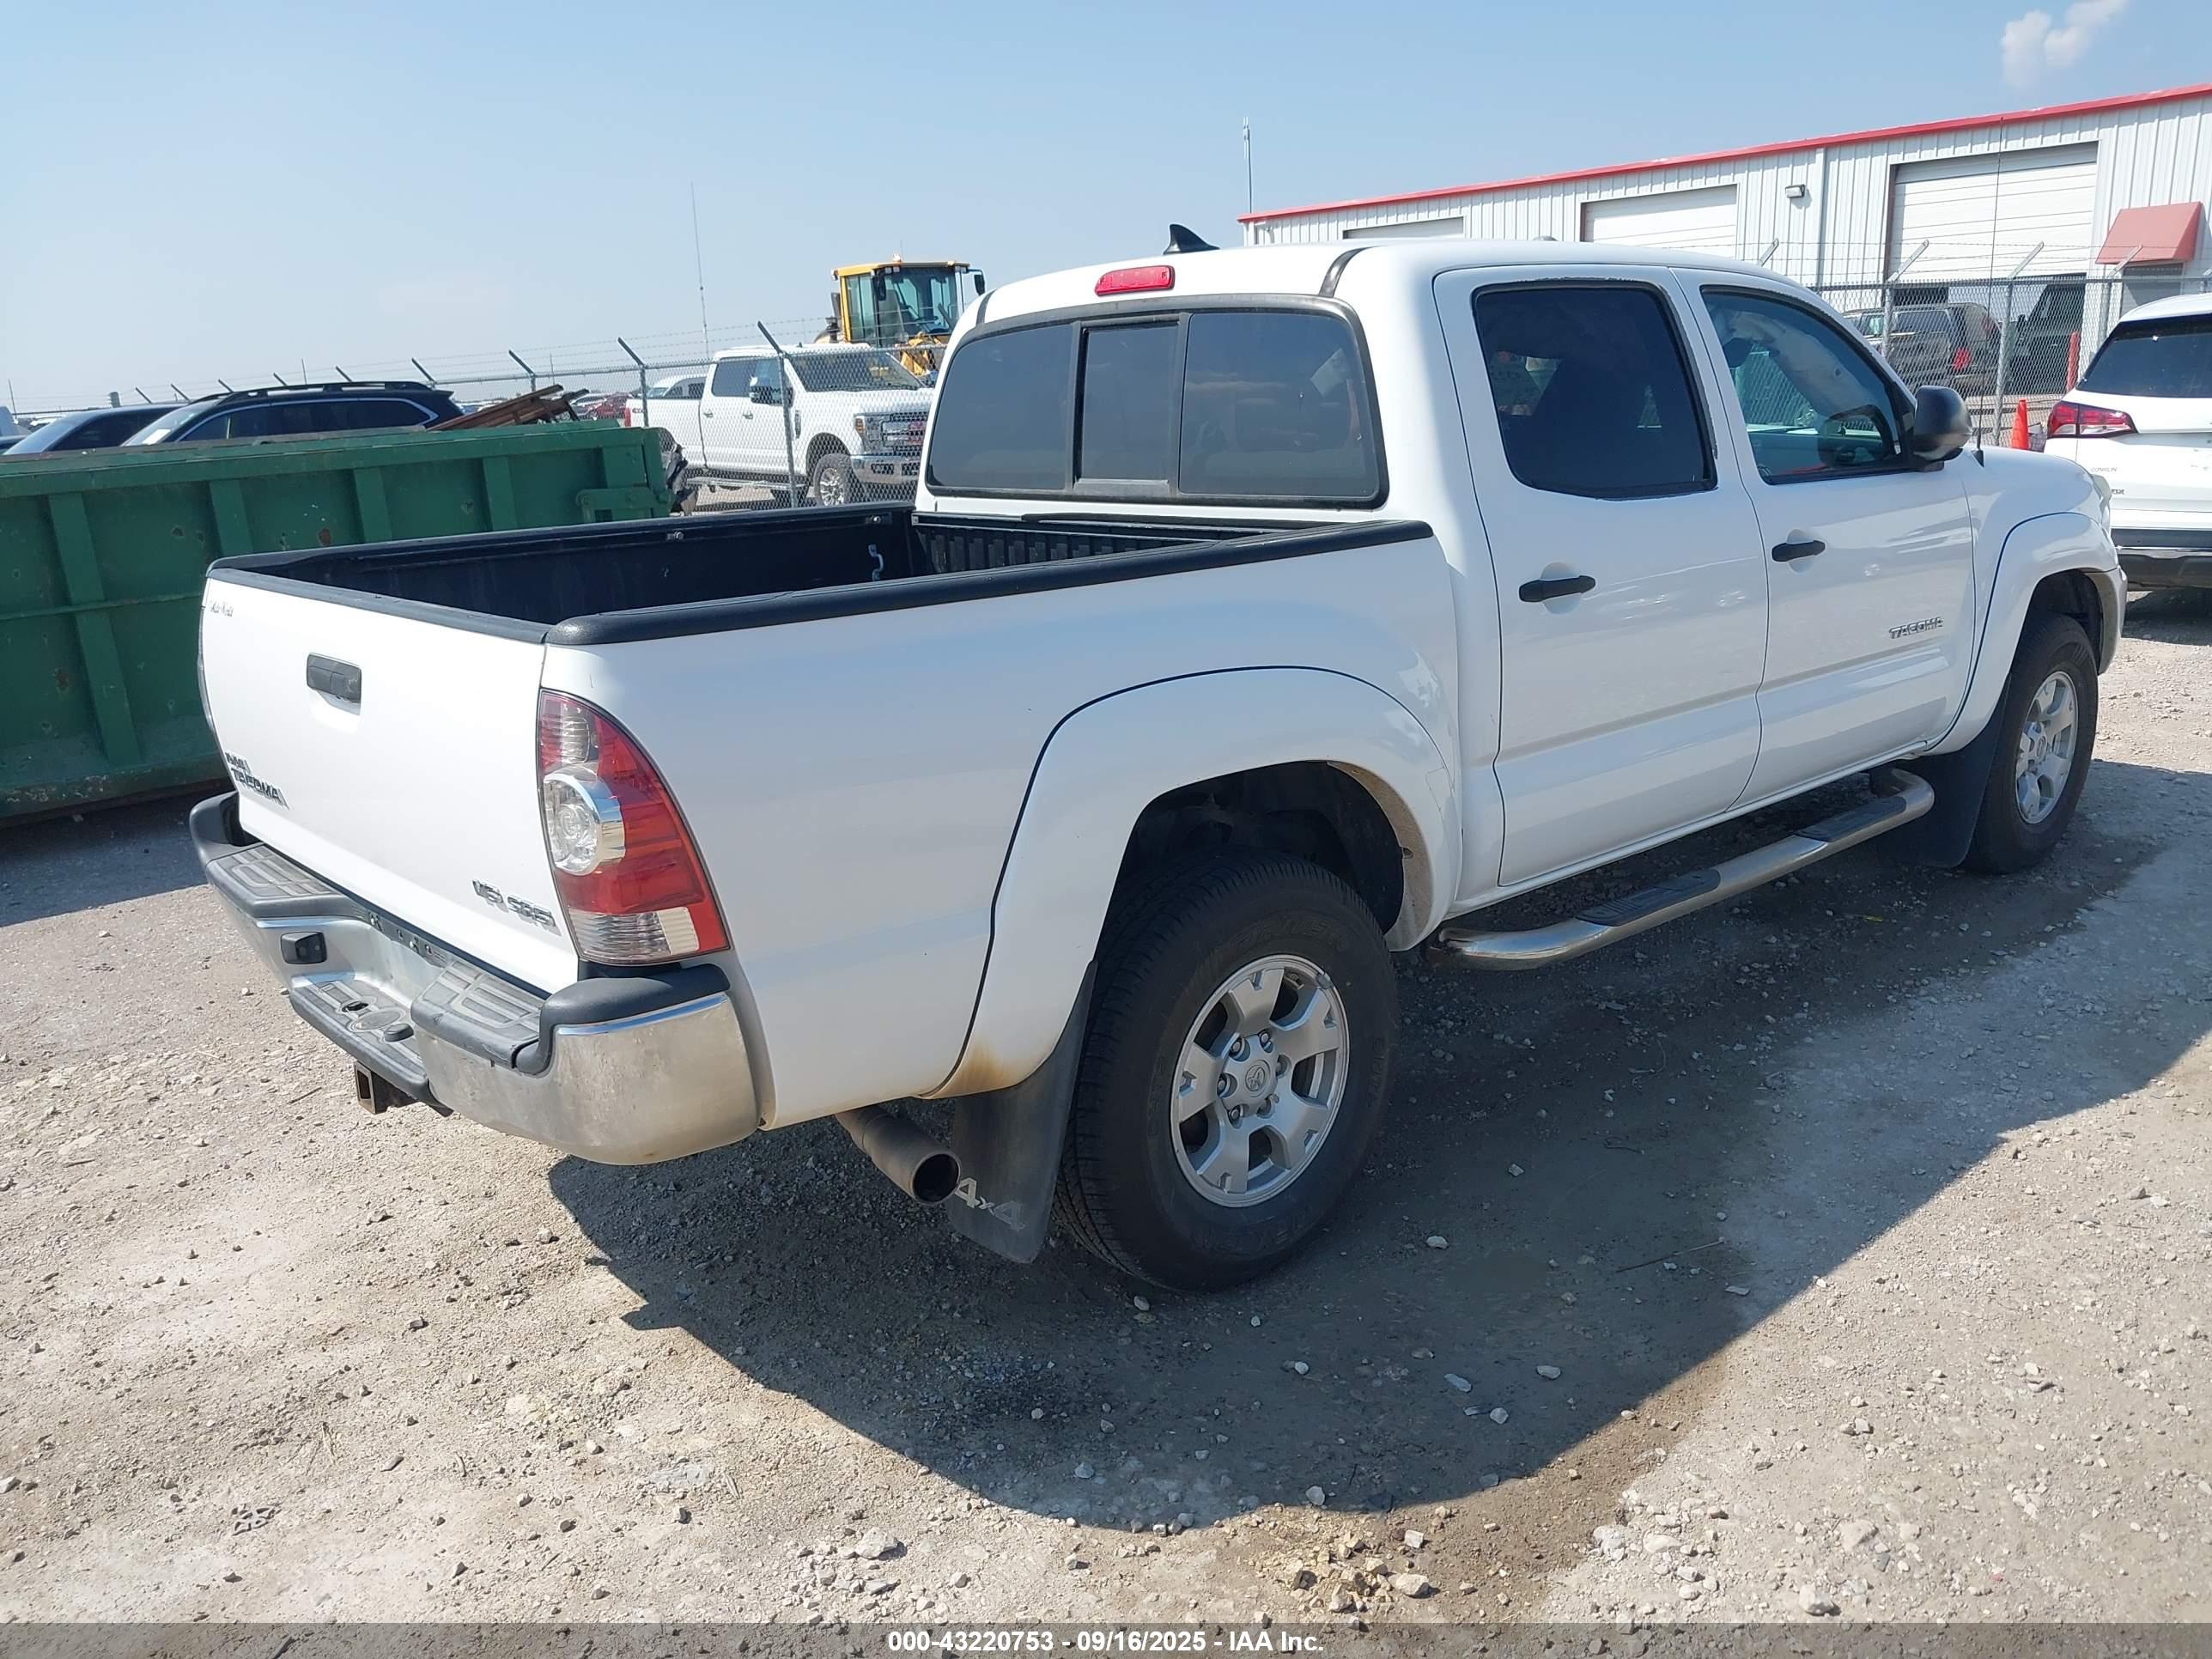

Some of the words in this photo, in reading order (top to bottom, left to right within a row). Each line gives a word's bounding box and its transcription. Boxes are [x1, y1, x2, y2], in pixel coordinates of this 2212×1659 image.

[1888, 616, 1944, 640] TACOMA
[231, 767, 285, 805] TACOMA
[472, 878, 505, 905] V6
[507, 895, 557, 929] SR5
